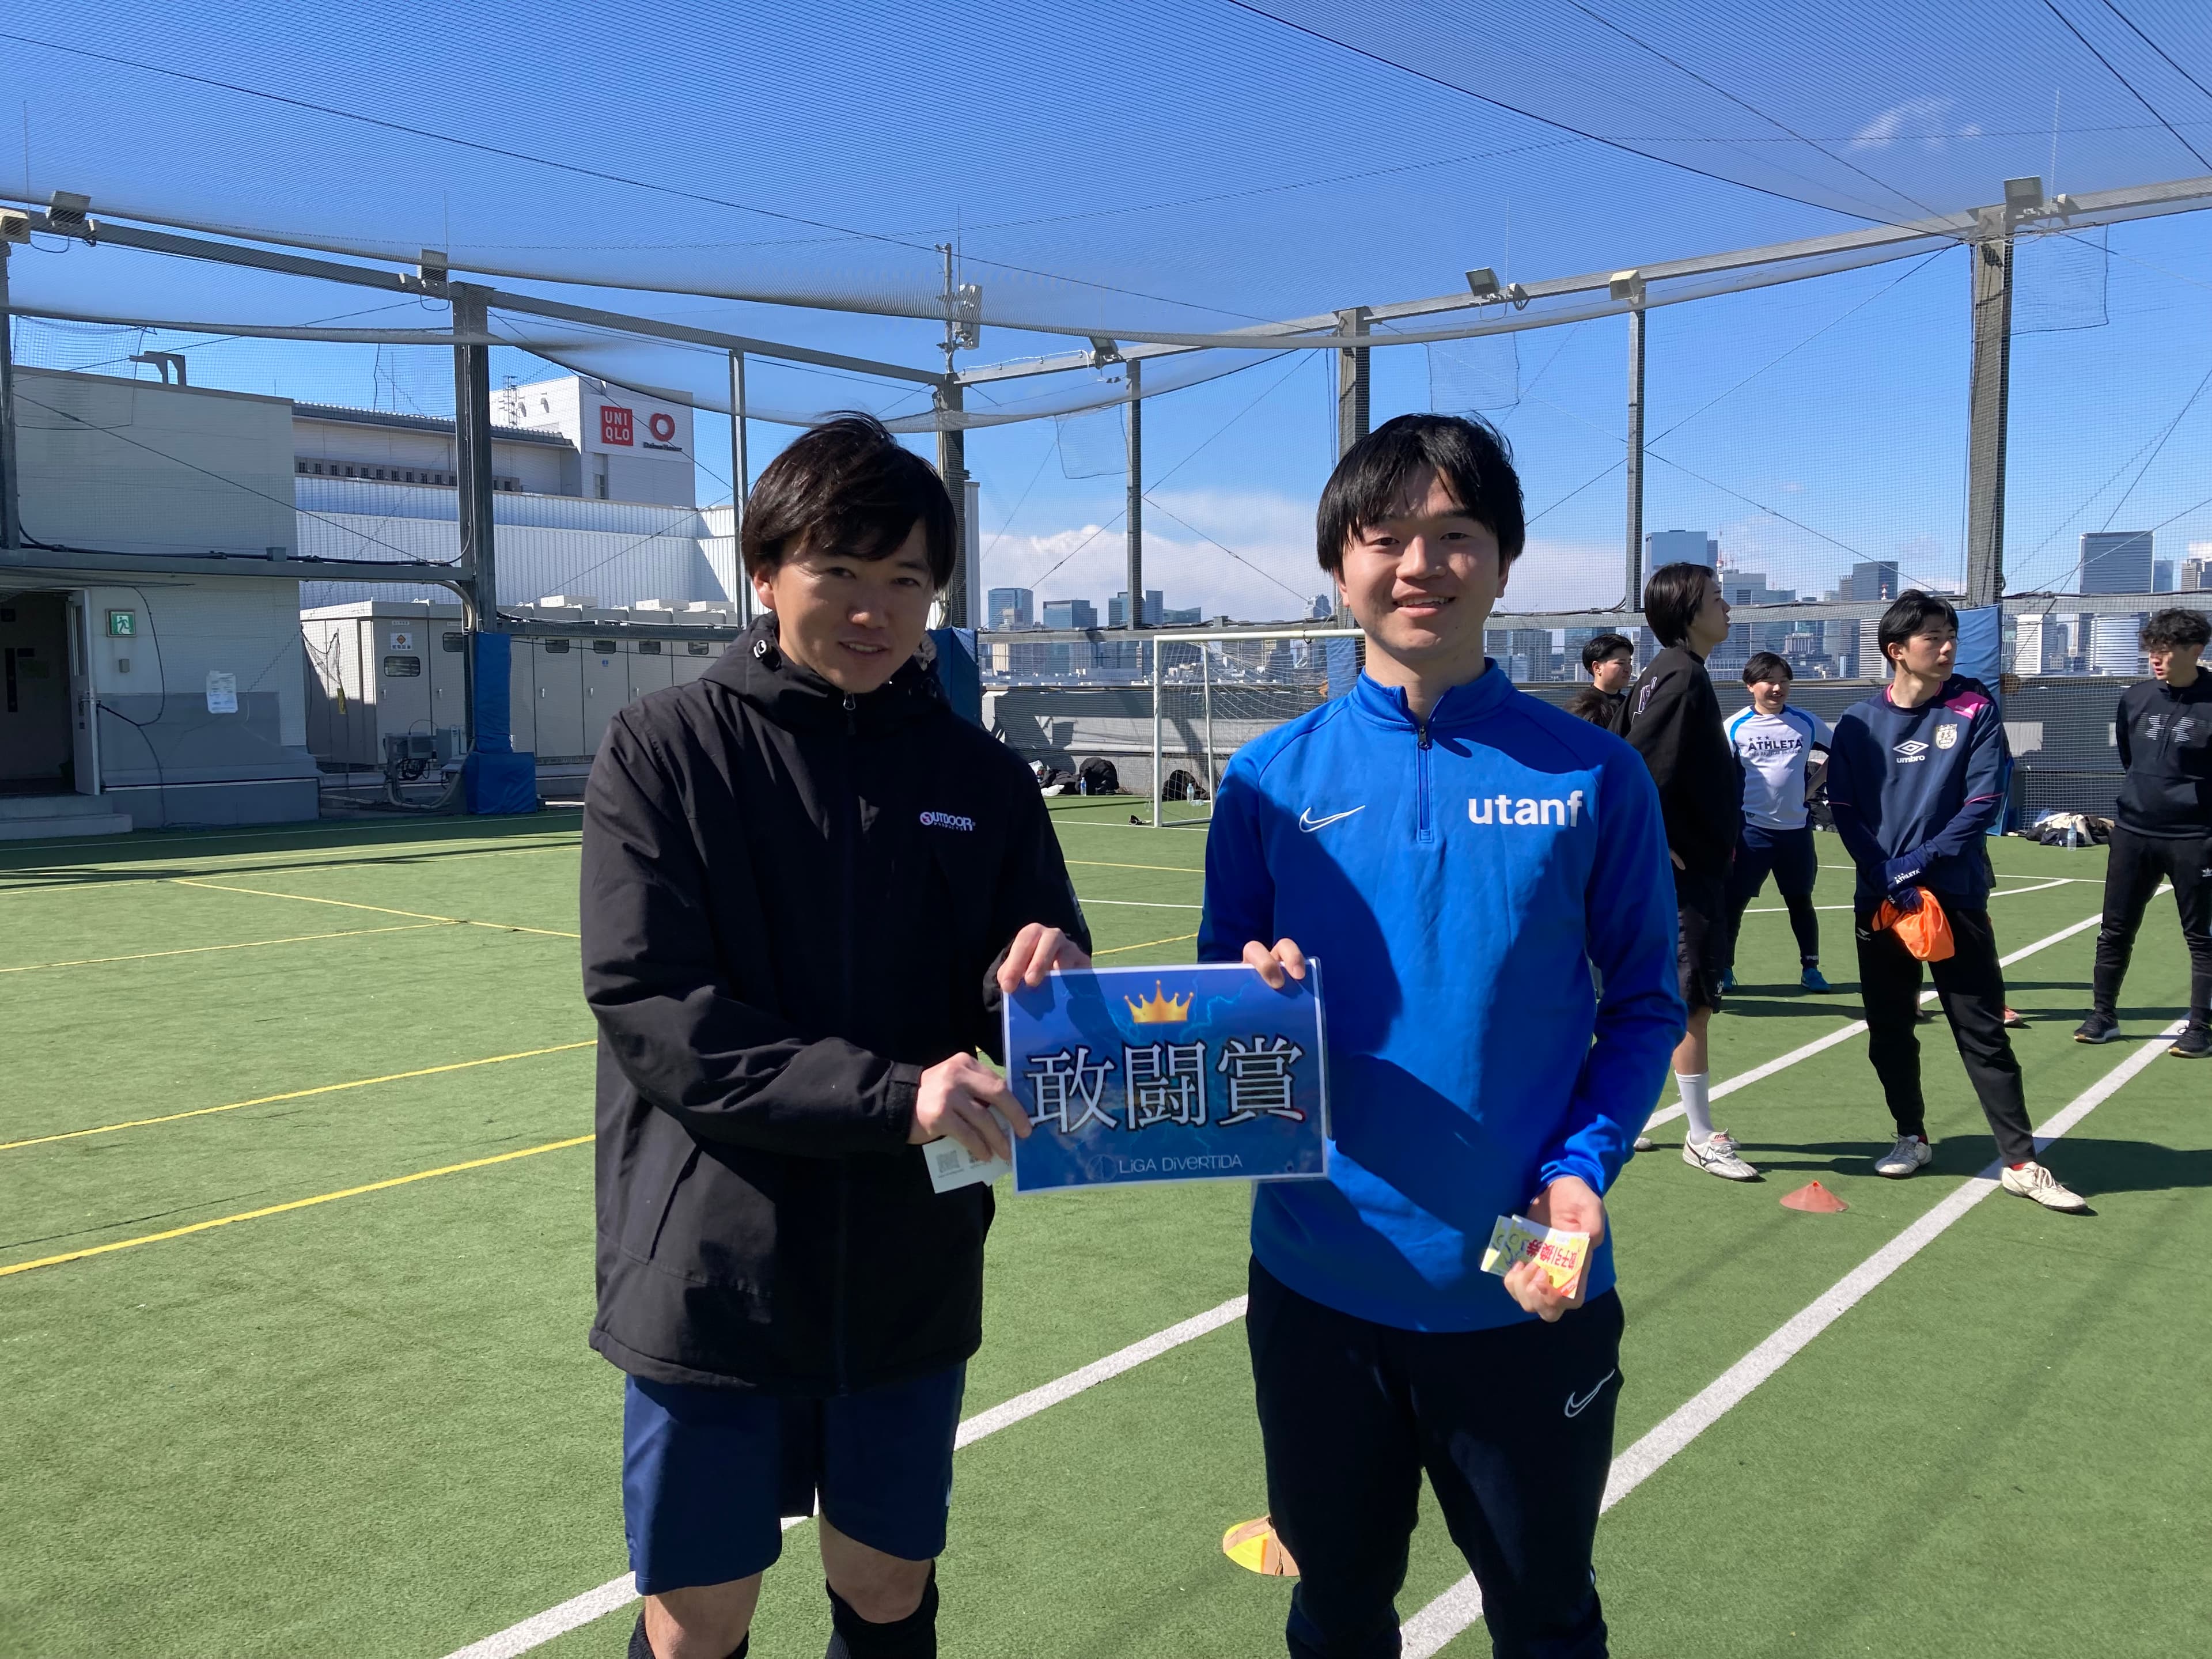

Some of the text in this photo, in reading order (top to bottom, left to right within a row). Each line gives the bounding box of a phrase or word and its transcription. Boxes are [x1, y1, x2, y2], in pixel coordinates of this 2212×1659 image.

[604, 411, 627, 426] UNI
[605, 426, 630, 441] QLO
[1748, 739, 1804, 751] ATHLETA
[1896, 755, 1926, 764] umbro
[1468, 790, 1583, 828] utanf
[920, 811, 973, 831] OUTDOOR
[1895, 869, 1921, 885] ATHLETA
[1024, 1035, 1305, 1134] 敢闘賞
